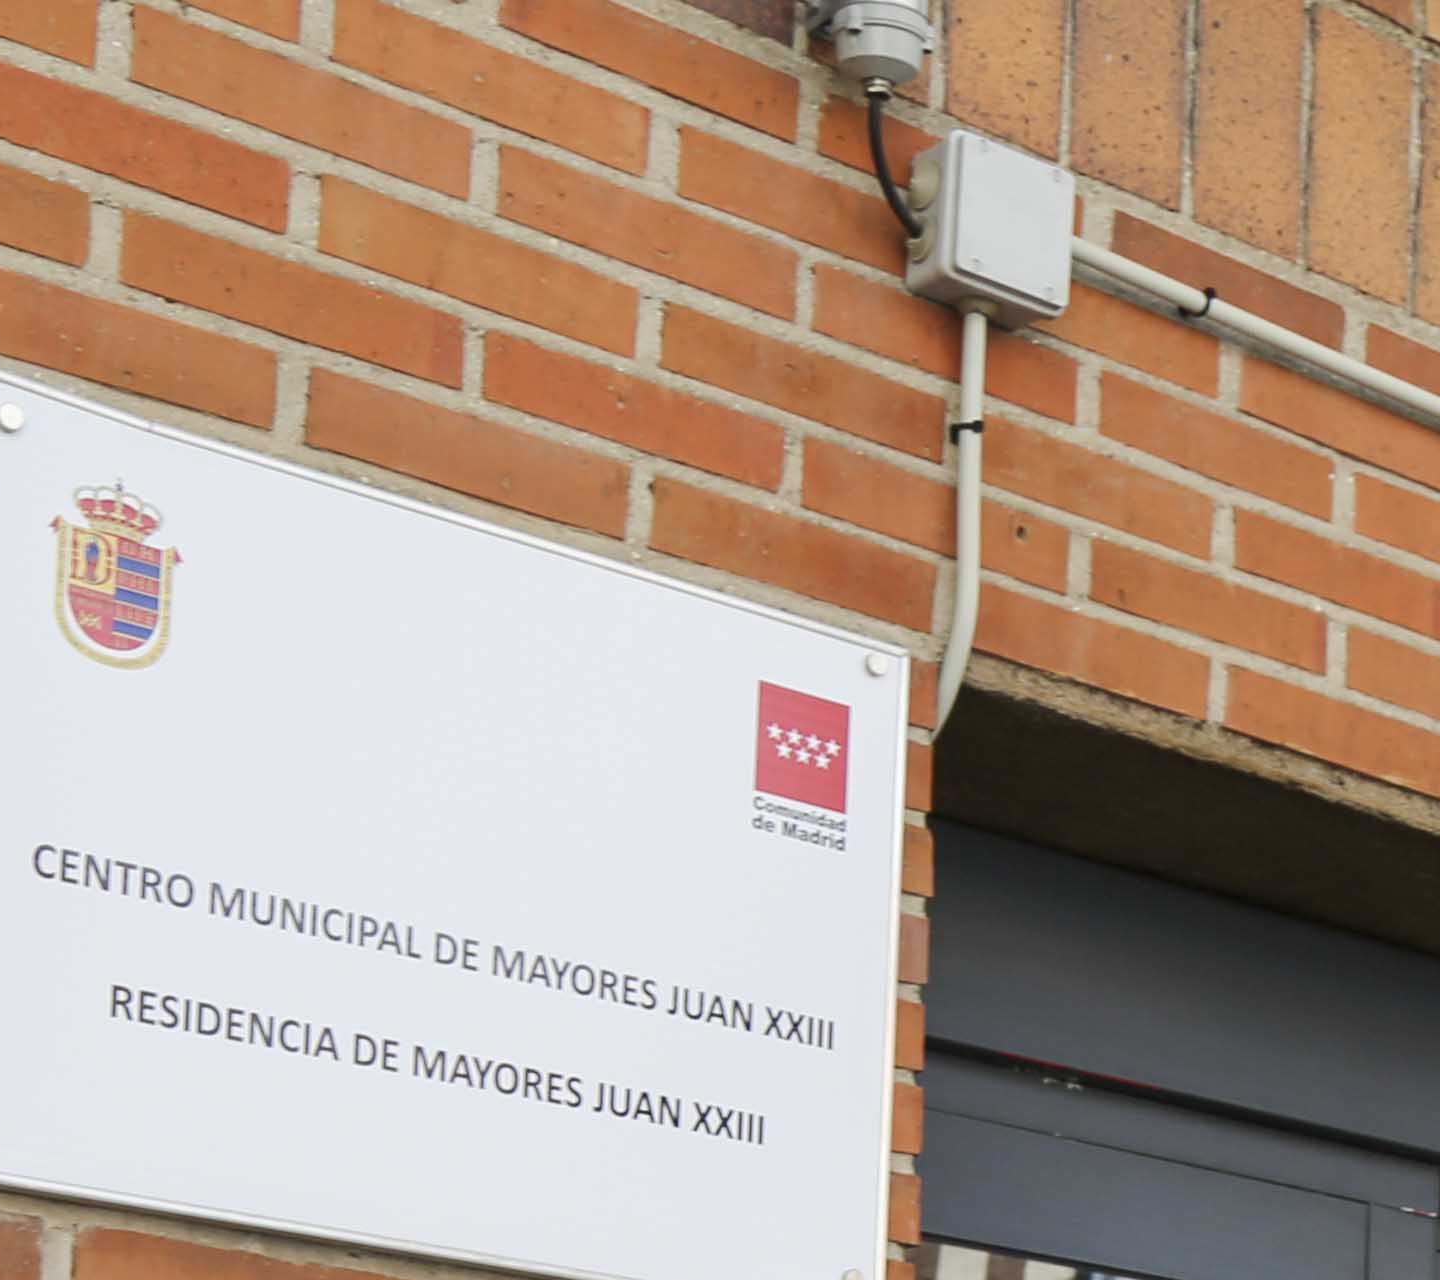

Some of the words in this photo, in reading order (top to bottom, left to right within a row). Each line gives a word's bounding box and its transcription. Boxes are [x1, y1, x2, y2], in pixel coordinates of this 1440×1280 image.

[751, 815, 776, 833] de
[781, 820, 847, 852] Madrid
[752, 796, 847, 833] Comunidad
[32, 843, 194, 908] CENTRO
[207, 881, 422, 959] MUNICIPAL
[433, 931, 480, 972] DE
[491, 944, 658, 1011] MAYORES
[666, 984, 754, 1033] JUAN
[763, 1005, 836, 1051] XXIII
[108, 983, 340, 1061] RESIDENCIA
[352, 1032, 400, 1073] DE
[411, 1043, 583, 1109] MAYORES
[591, 1081, 682, 1128] JUAN
[692, 1101, 766, 1146] XXIII
